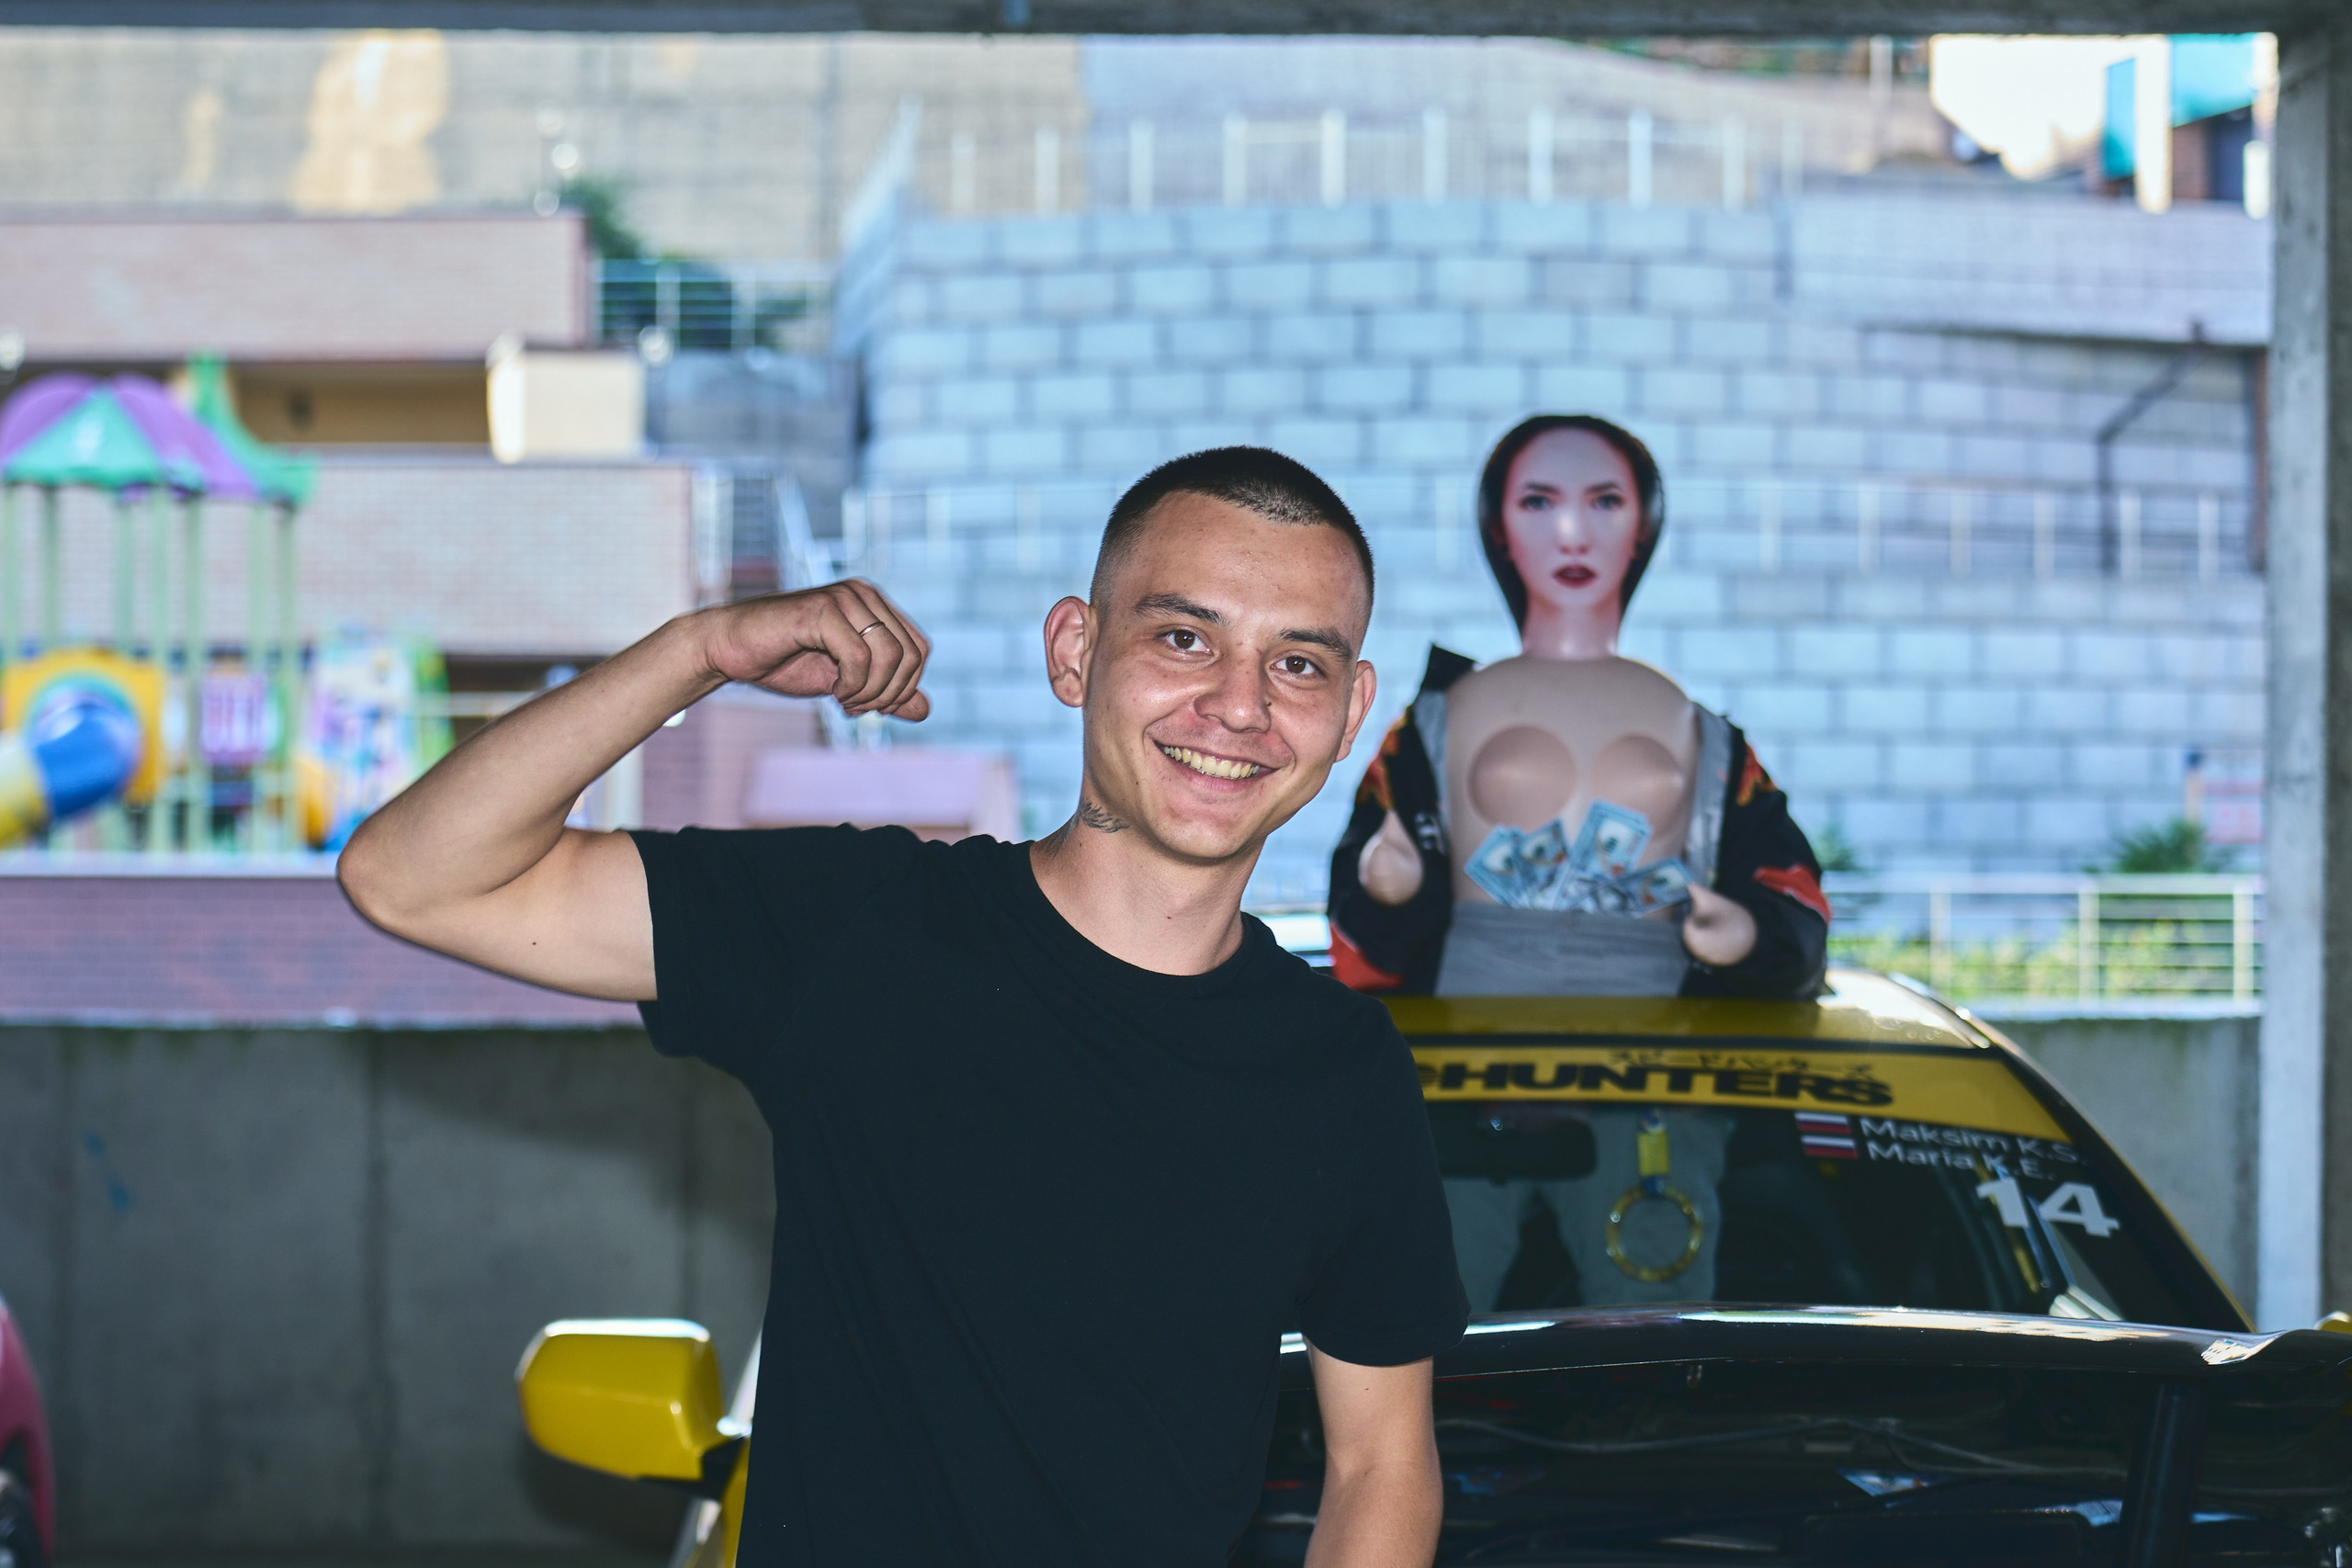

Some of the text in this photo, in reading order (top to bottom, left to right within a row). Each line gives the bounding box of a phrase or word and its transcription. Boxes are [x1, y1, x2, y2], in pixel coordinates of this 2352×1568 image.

[1859, 1116, 2008, 1154] Maksim
[1866, 1141, 1975, 1171] Maria
[1976, 1175, 2120, 1237] 14
